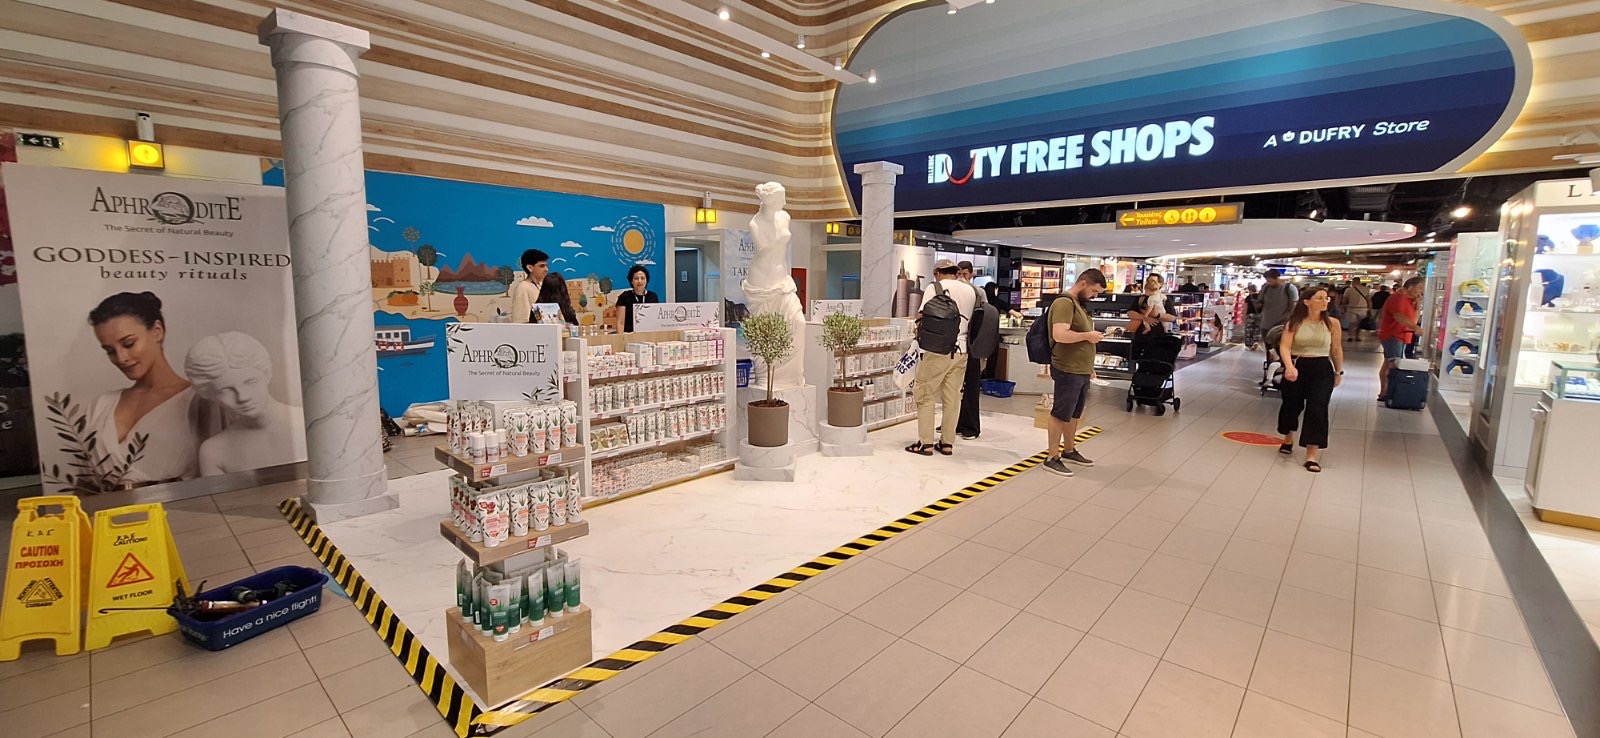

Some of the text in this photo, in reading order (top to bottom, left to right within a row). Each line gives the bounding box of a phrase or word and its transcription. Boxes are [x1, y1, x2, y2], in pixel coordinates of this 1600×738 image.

[1263, 119, 1430, 148] A DUFRY Store
[1010, 133, 1085, 176] FREE
[1089, 116, 1215, 167] SHOPS
[104, 224, 122, 232] The
[124, 225, 154, 234] Secret
[167, 227, 201, 236] Natural
[203, 229, 234, 238] Beauty
[100, 266, 248, 281] beauty rituals
[732, 267, 748, 277] TAK
[21, 545, 59, 557] CAUTION
[15, 559, 64, 569] ΠΡΟΣΟΧΗ
[129, 589, 153, 598] FLOOR
[223, 623, 253, 639] Have
[255, 617, 263, 625] a
[266, 607, 289, 621] nice
